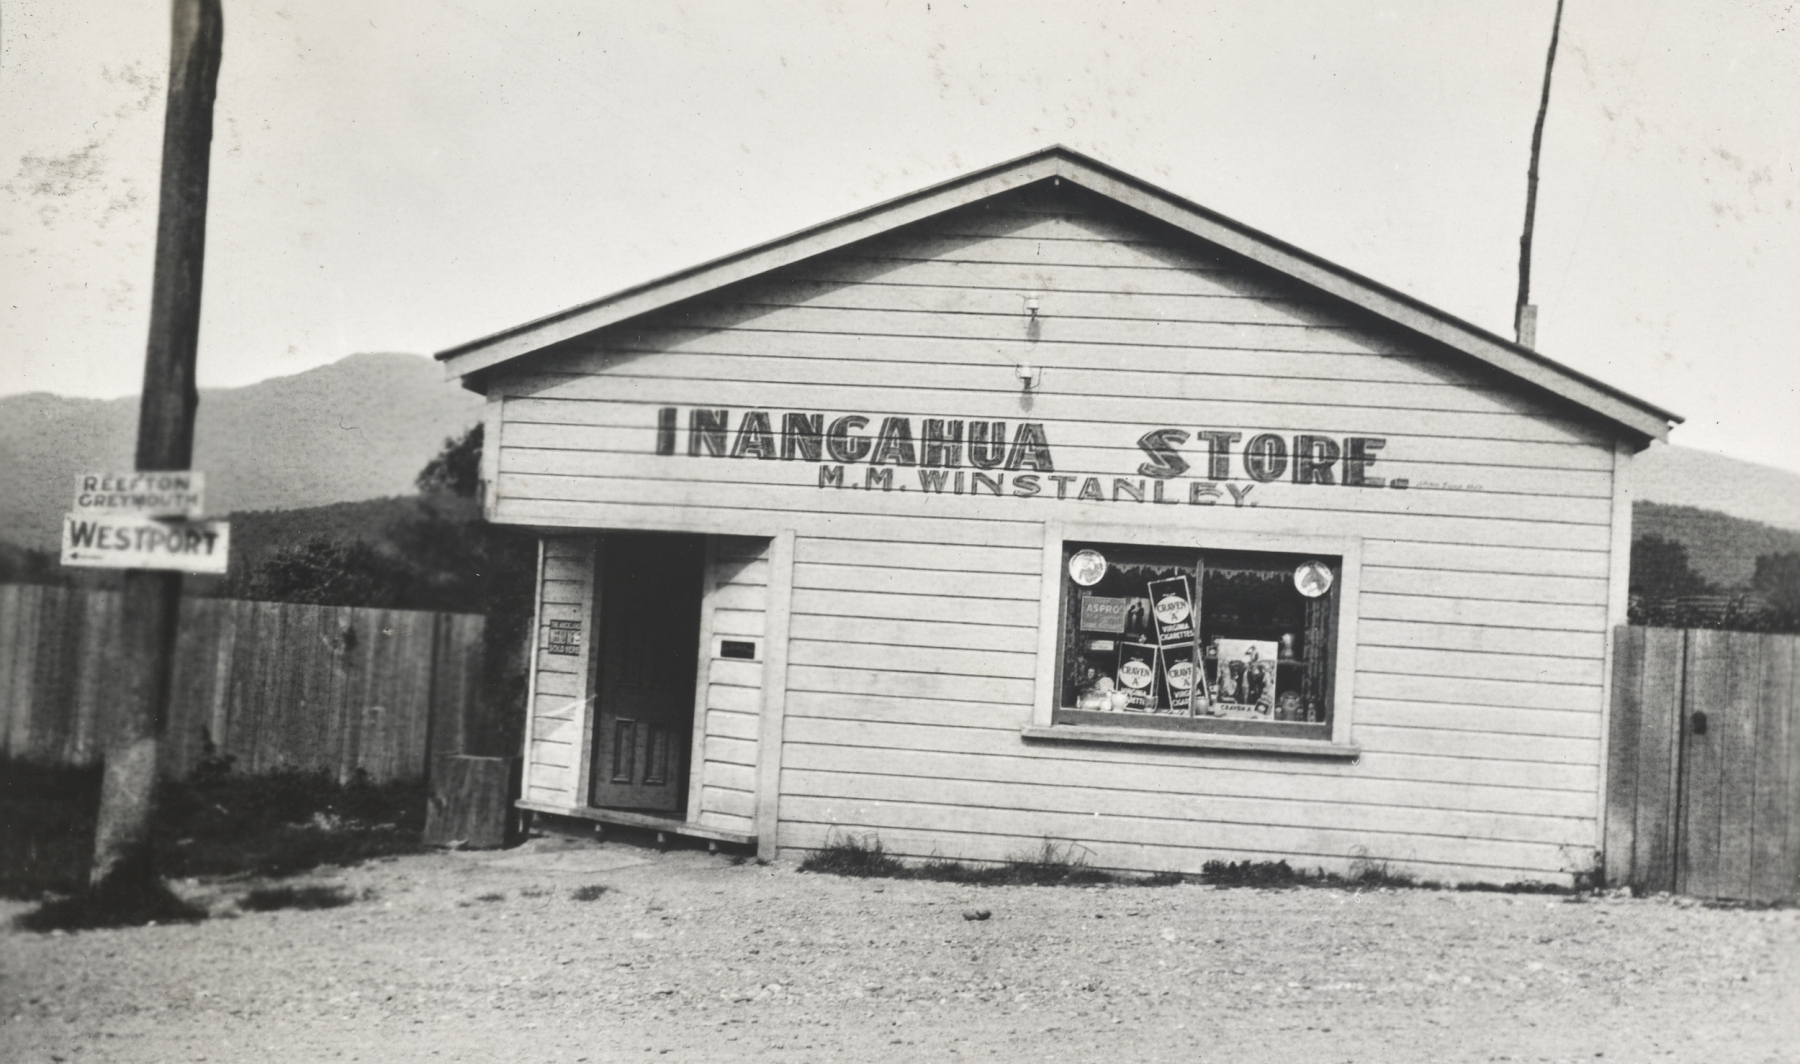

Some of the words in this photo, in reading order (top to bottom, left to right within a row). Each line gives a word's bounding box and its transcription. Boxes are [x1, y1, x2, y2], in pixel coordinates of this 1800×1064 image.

[656, 407, 1054, 472] INANGAHUA
[1136, 428, 1410, 490] STORE.
[83, 476, 191, 492] REEFTON
[78, 493, 198, 508] GREYMOUTH
[70, 520, 219, 556] WESTPORT
[1156, 601, 1186, 613] CRAVEN
[1161, 622, 1190, 634] VIRGINIA
[1160, 630, 1195, 641] CIGARETTES
[1121, 665, 1150, 677] CRAVEN
